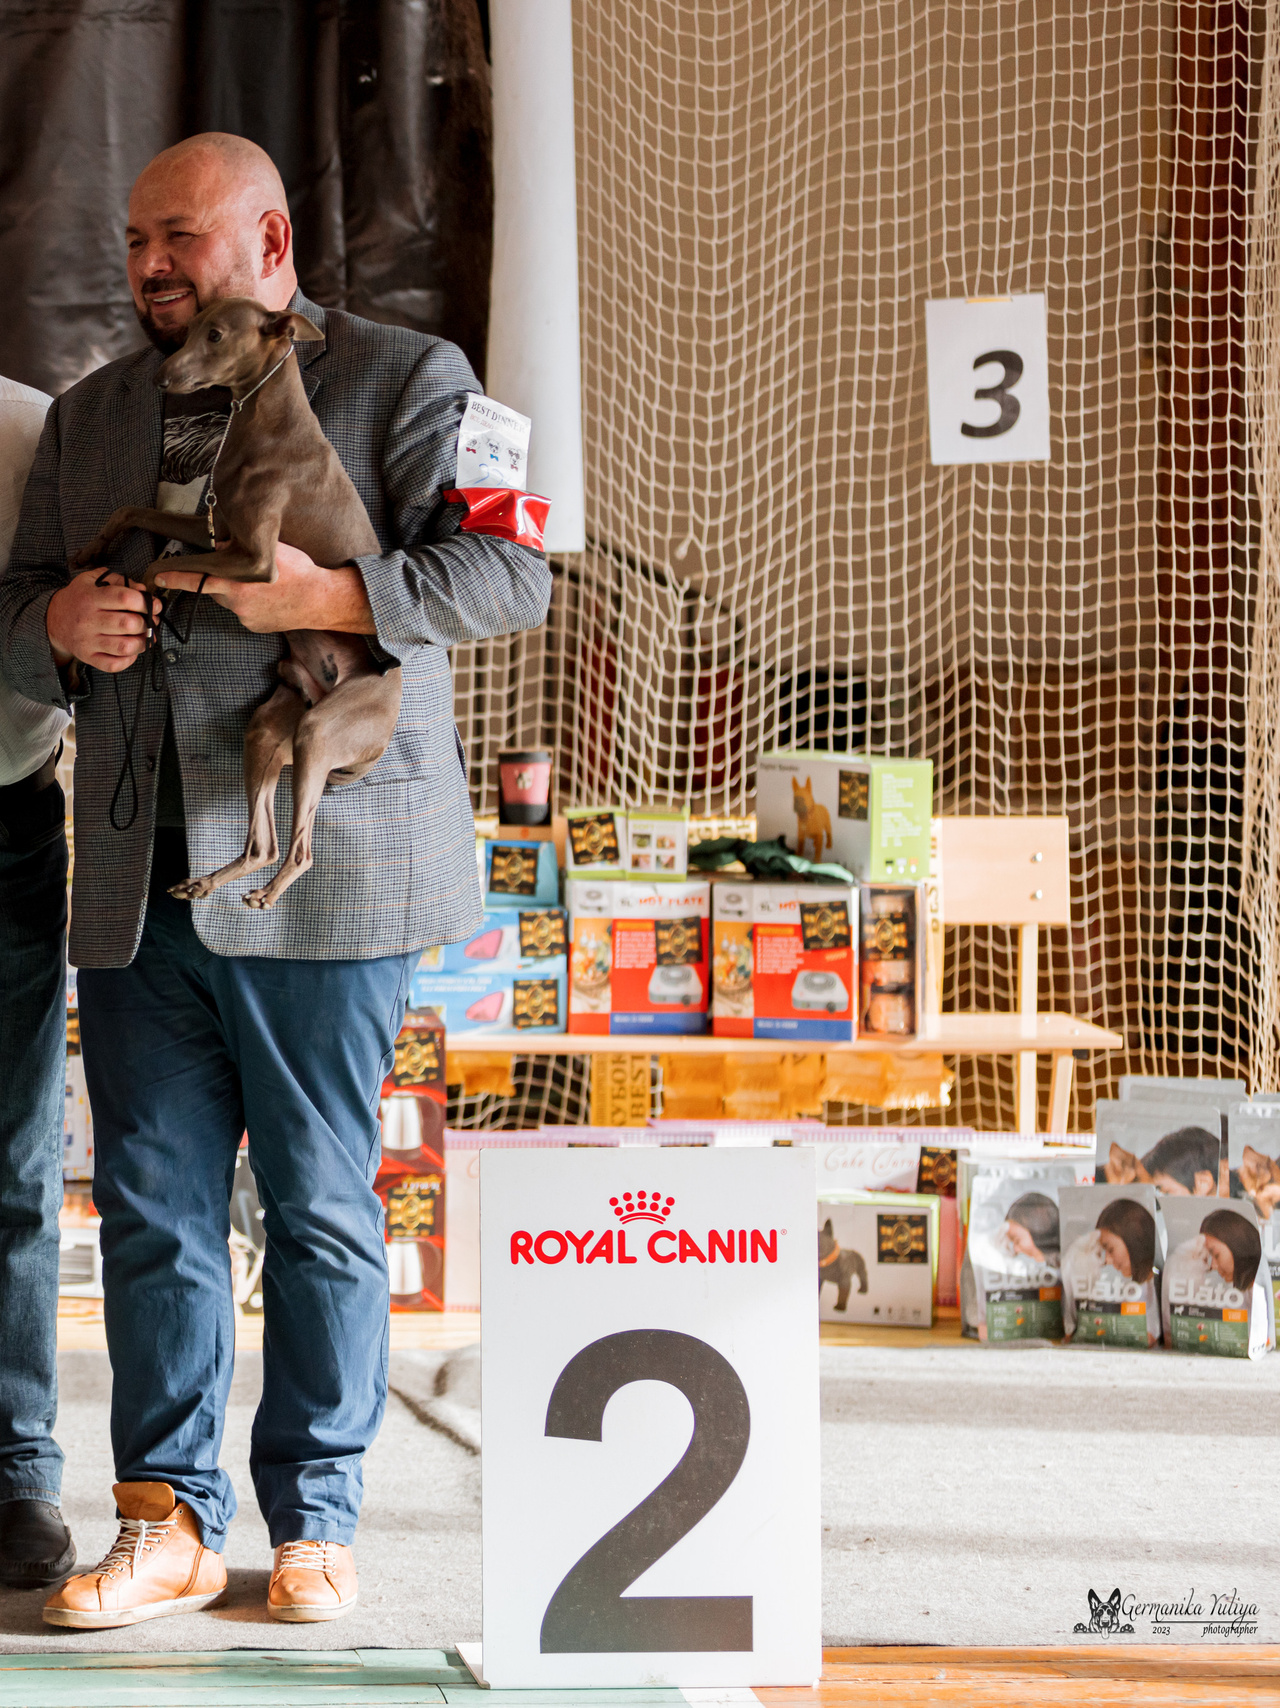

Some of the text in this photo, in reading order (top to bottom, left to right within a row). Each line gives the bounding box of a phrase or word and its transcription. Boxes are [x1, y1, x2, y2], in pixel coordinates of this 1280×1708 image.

[471, 401, 492, 418] BEST
[960, 350, 1023, 437] 3
[510, 1228, 778, 1264] ROYAL CANIN
[1073, 1272, 1143, 1301] Eláto
[1168, 1278, 1245, 1309] Eláto
[539, 1328, 753, 1653] 2
